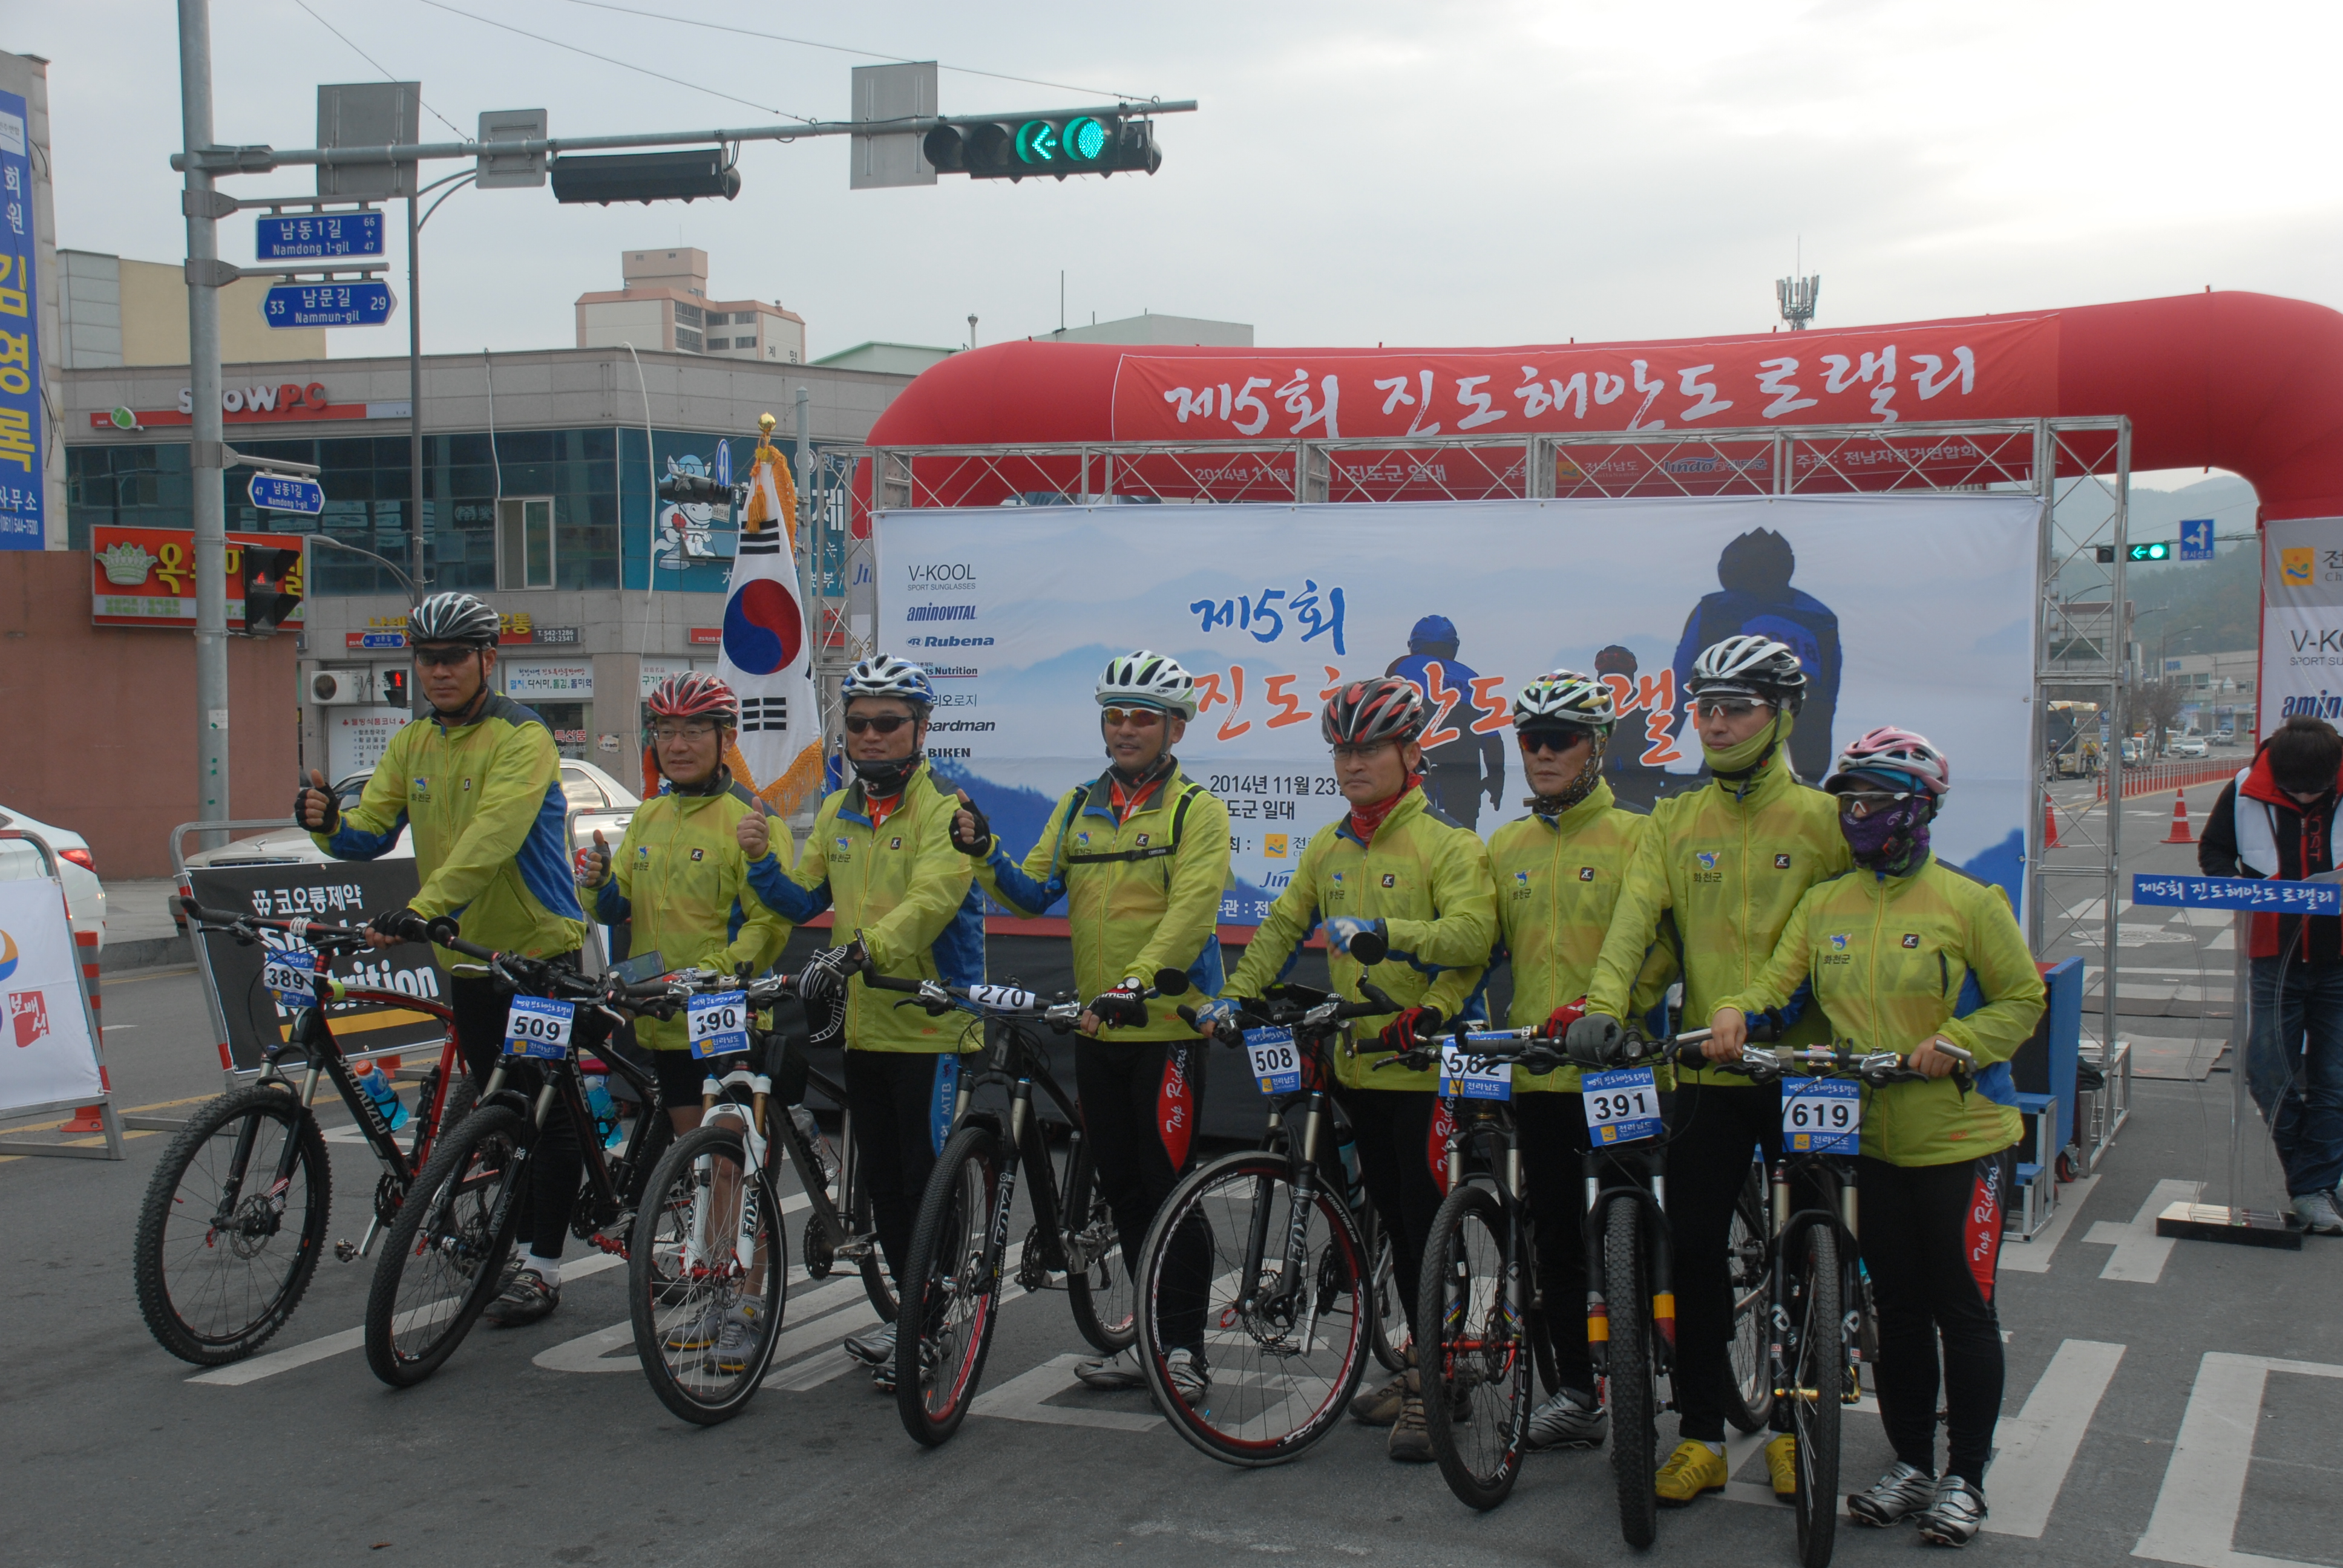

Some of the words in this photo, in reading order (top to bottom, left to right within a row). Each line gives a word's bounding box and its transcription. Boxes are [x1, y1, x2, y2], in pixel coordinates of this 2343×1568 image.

[281, 219, 341, 240] 남동1길
[364, 217, 375, 227] 66
[273, 244, 322, 256] Namdong
[326, 241, 350, 255] 1-gil
[364, 242, 375, 251] 47
[270, 301, 285, 315] 33
[303, 288, 350, 308] 남문길
[370, 297, 386, 310] 29
[295, 310, 359, 324] Nammun-gil
[1194, 468, 1249, 482] 2014년
[1346, 465, 1404, 483] 진도군
[254, 486, 263, 496] 47
[273, 482, 303, 497] 남동1길
[312, 494, 320, 503] 51
[268, 497, 293, 509] Namdong
[908, 564, 977, 581] V-KOOL
[1190, 578, 1346, 656] 제5회
[925, 636, 995, 647] Rubena
[935, 666, 978, 675] Nutrition
[2290, 656, 2325, 666] SPORT
[1210, 775, 1268, 794] 2014년
[1273, 776, 1310, 795] 11월
[1226, 799, 1258, 820] 도군
[1262, 800, 1295, 820] 일대
[1693, 872, 1723, 884] 화천군
[275, 884, 364, 915] 코오롱제약
[2138, 880, 2185, 901] 제5회
[1823, 954, 1851, 965] 화천군
[268, 967, 304, 990] 389
[977, 985, 1026, 1008] 270
[513, 1016, 561, 1041] 509
[696, 1008, 736, 1036] 390
[1255, 1047, 1293, 1072] 508
[1166, 1047, 1188, 1099] Riders
[337, 1054, 388, 1136] SPECIALIZED
[1466, 1082, 1500, 1091] 전라남도
[941, 1083, 952, 1116] MTB
[1593, 1093, 1646, 1120] 391
[1165, 1106, 1186, 1134] Top
[1792, 1103, 1849, 1128] 619
[1617, 1121, 1653, 1134] 전라남도
[1974, 1165, 1999, 1224] Riders
[741, 1189, 761, 1240] FOX
[994, 1187, 1014, 1245] FOX
[1286, 1201, 1308, 1266] FOX
[1973, 1230, 1993, 1261] Top
